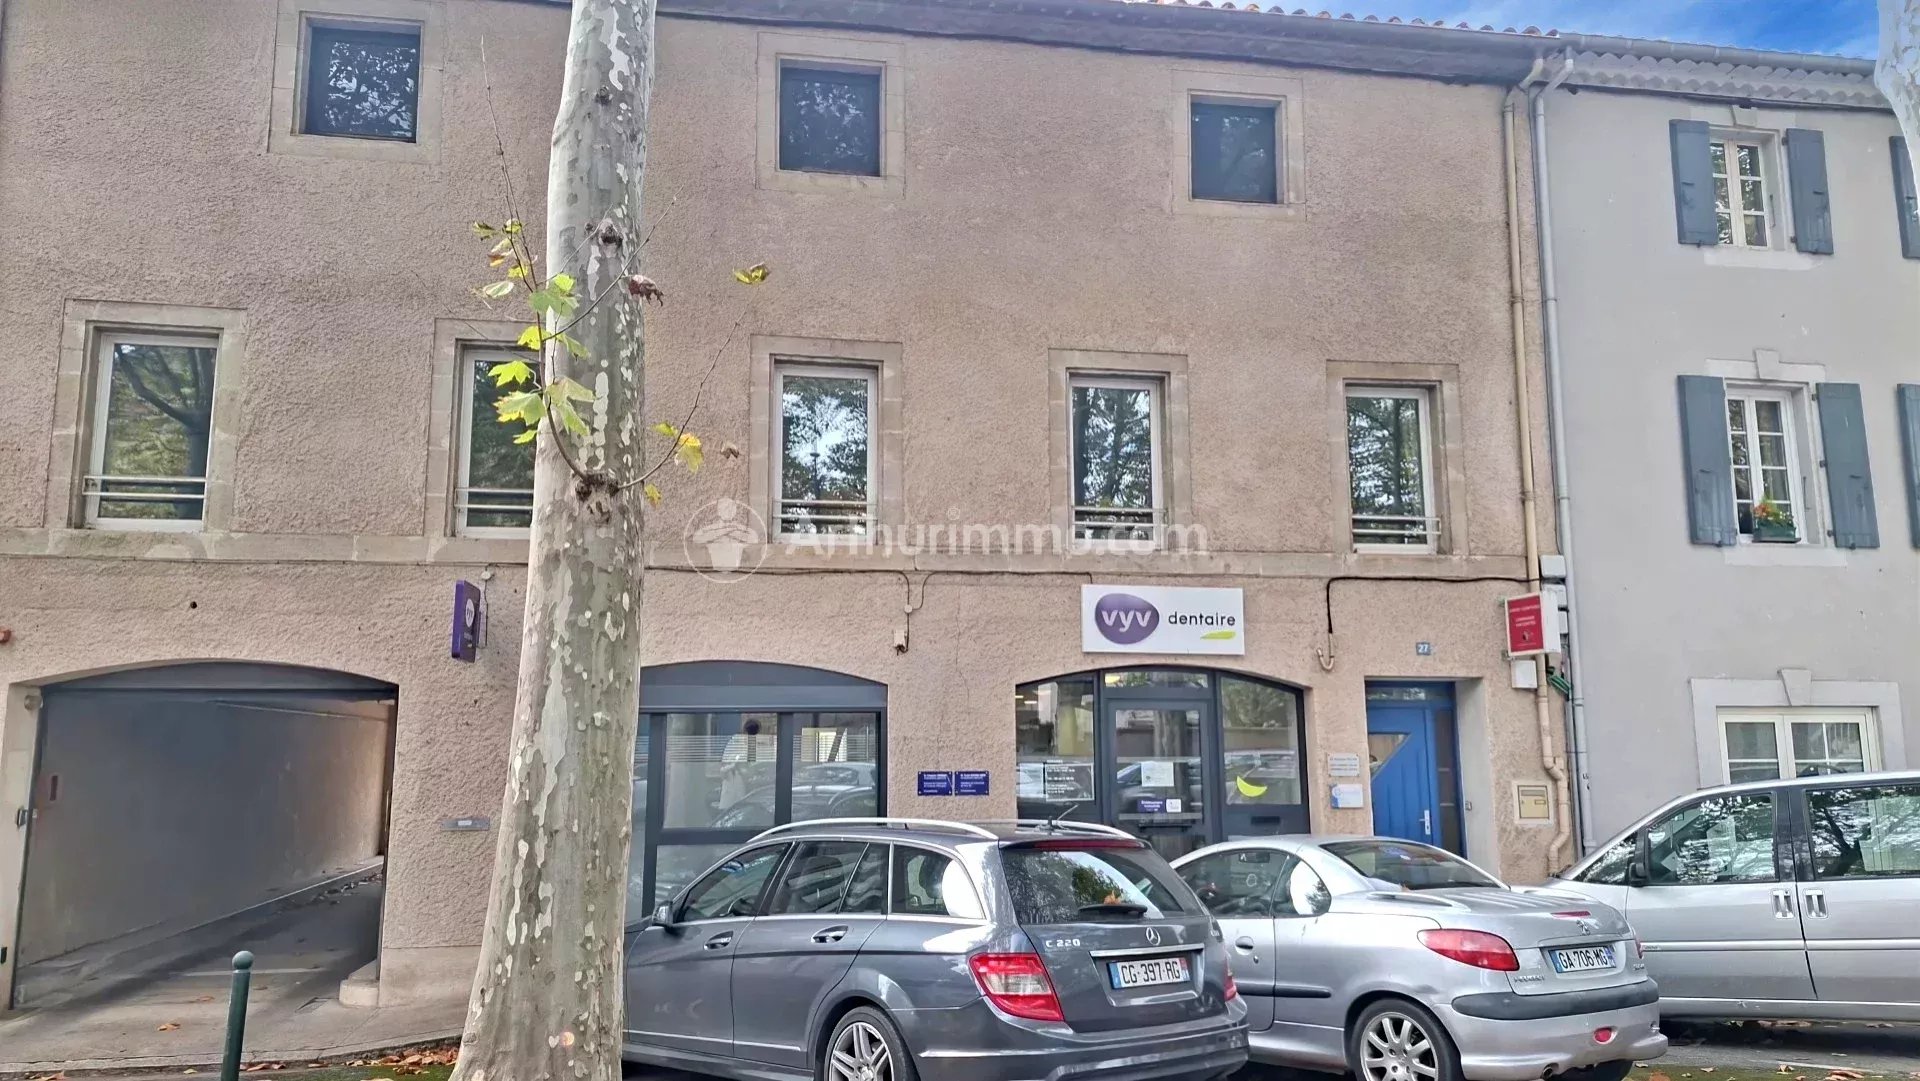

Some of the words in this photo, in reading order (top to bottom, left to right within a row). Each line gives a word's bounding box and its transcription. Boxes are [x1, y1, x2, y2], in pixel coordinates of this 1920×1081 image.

[1101, 609, 1152, 633] vyv
[1168, 611, 1236, 627] dentaire
[1046, 940, 1052, 948] C
[1056, 938, 1081, 947] 220
